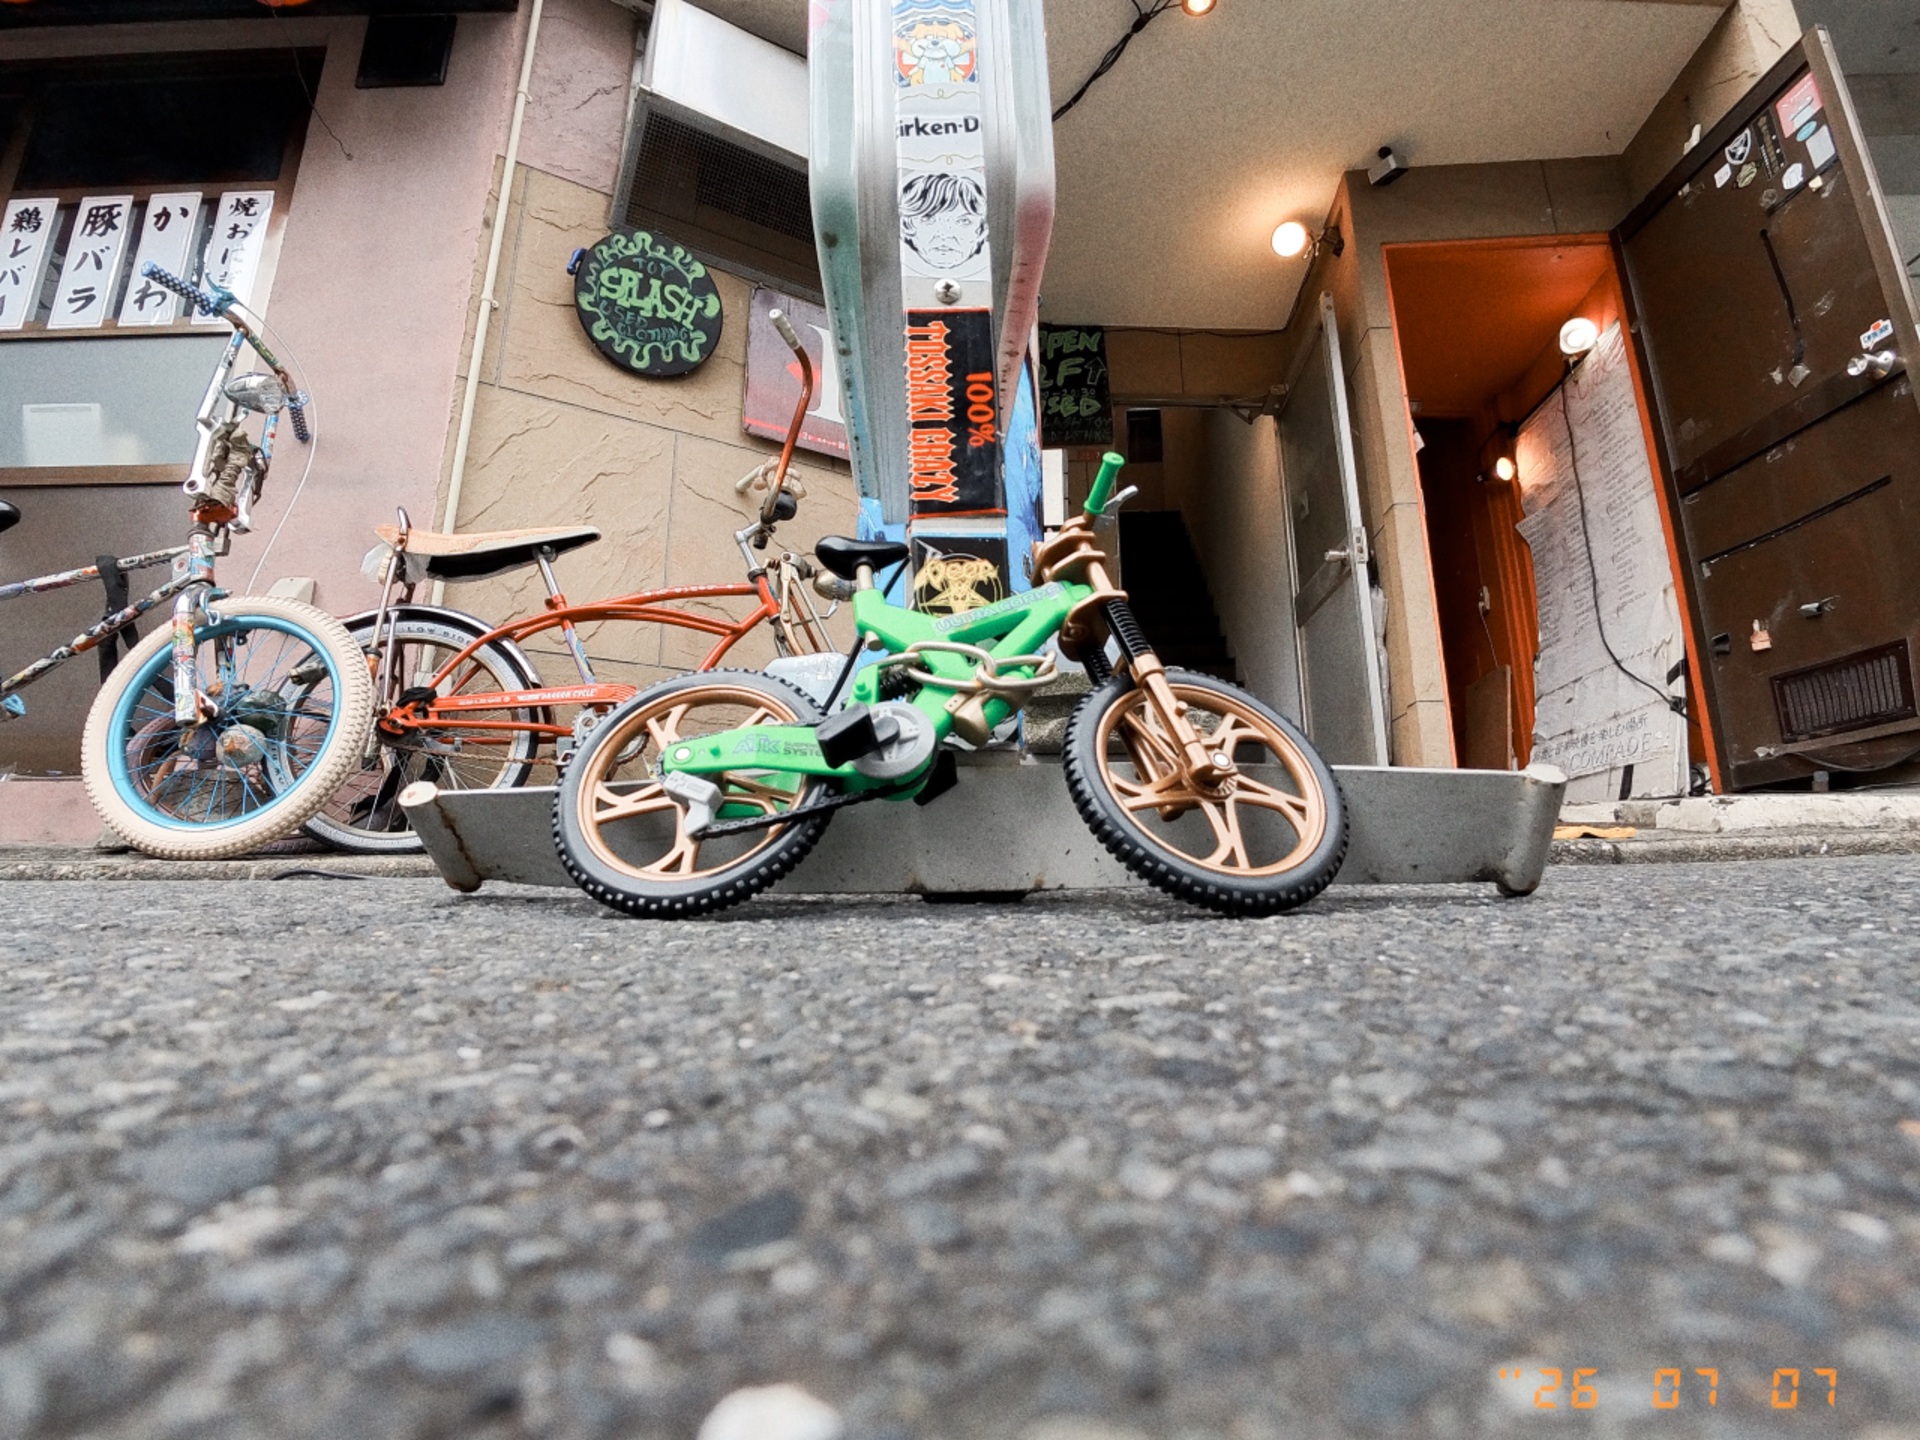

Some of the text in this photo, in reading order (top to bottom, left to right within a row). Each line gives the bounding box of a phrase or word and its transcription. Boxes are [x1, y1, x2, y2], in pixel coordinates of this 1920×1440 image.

[0, 206, 43, 317] 鶏レバー
[67, 203, 123, 314] 豚バラ
[133, 206, 189, 311] かわ
[218, 197, 260, 290] 焼おにぎ
[632, 257, 674, 278] TOY
[600, 267, 704, 331] SPLASH
[600, 300, 648, 328] USED
[617, 321, 689, 341] CLOTHING
[903, 320, 960, 503] TOSSAKI CRAZY
[965, 371, 996, 448] 100%
[407, 626, 436, 634] LOW
[934, 606, 998, 633] ULTRA
[572, 688, 596, 698] CYCLE
[783, 747, 825, 757] SYSTE
